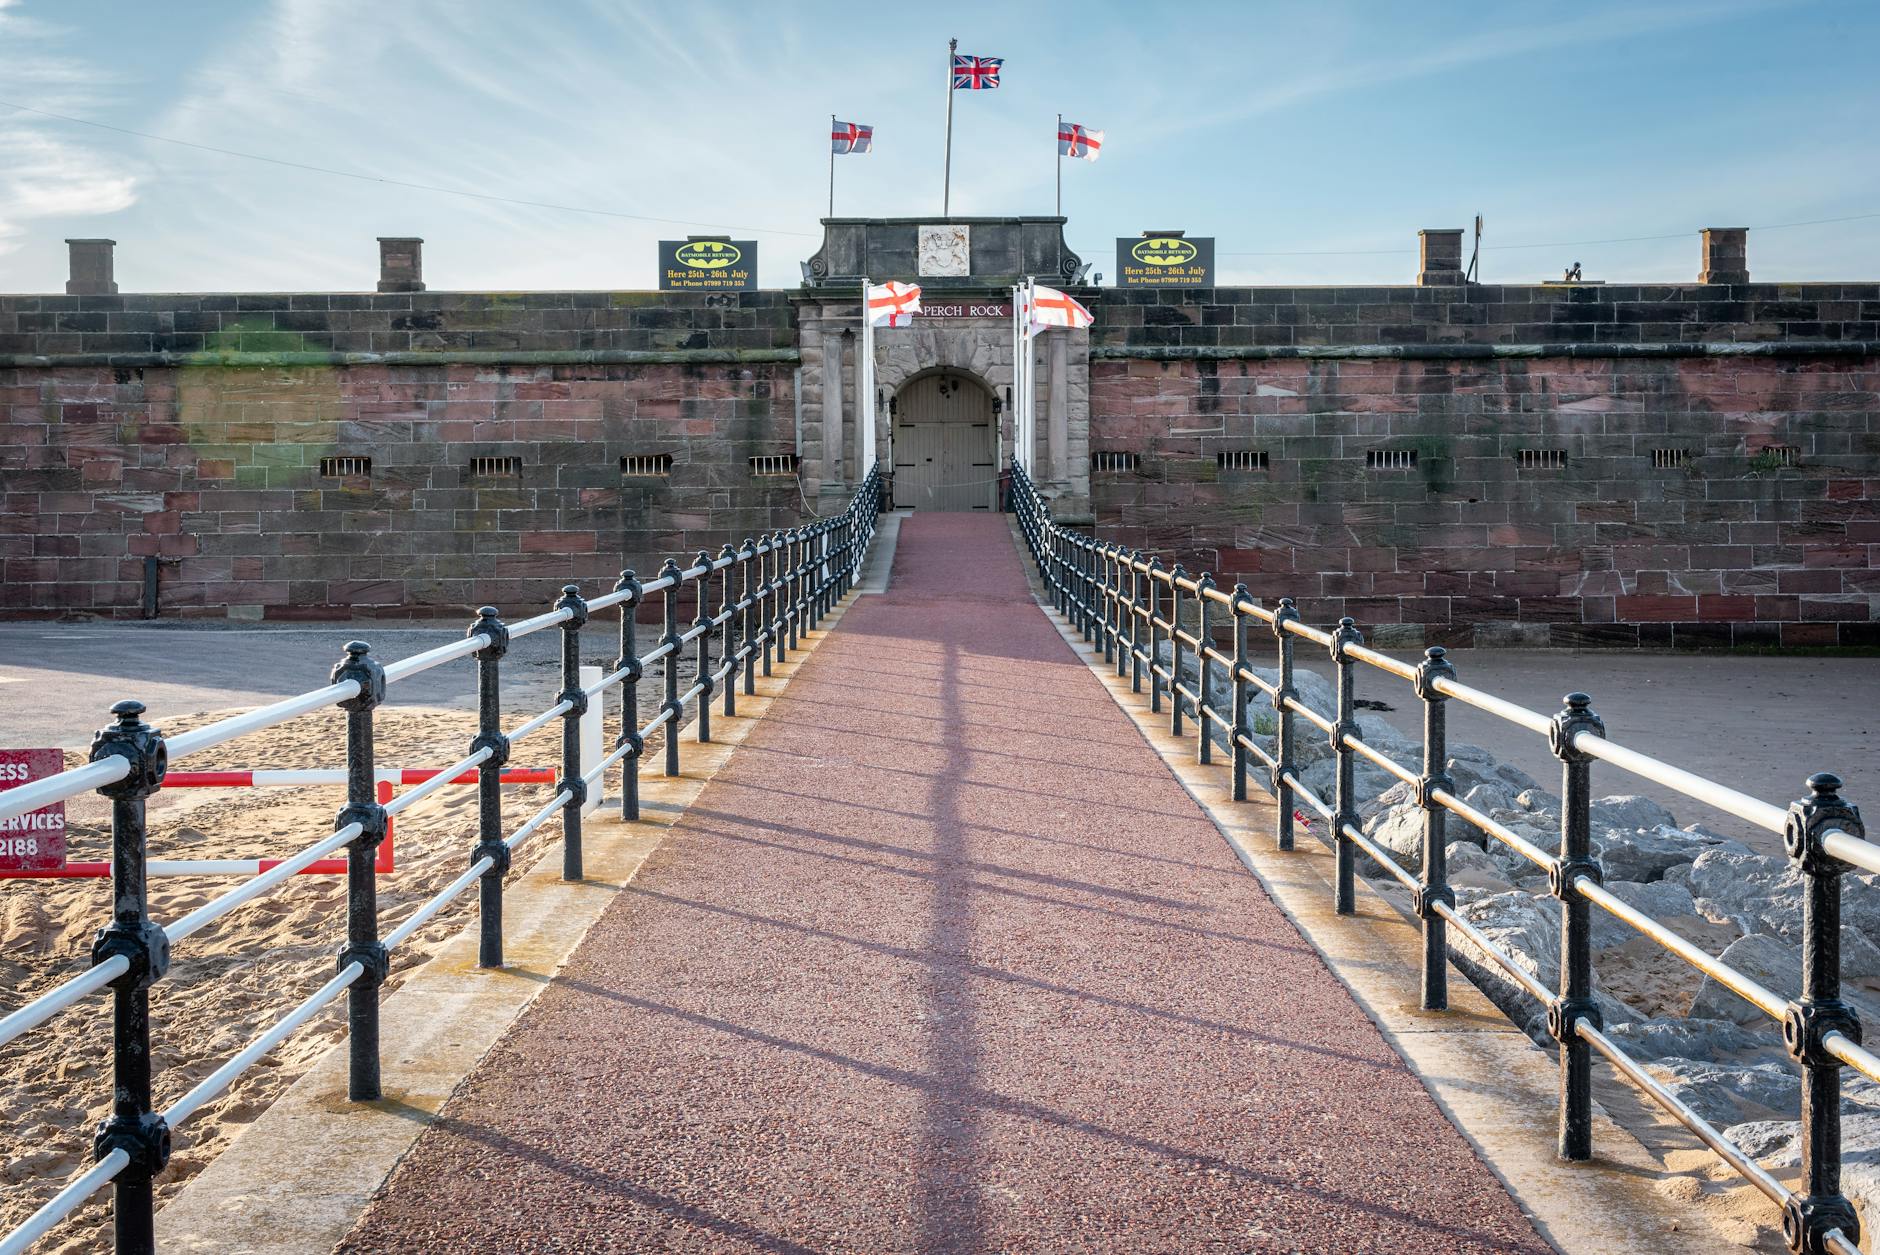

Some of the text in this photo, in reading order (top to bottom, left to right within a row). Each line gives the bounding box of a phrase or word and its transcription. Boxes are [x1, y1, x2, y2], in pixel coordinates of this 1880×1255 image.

[667, 270, 686, 278] Here
[688, 270, 704, 278] 25th
[711, 270, 727, 278] 26th
[731, 270, 749, 280] July
[1124, 267, 1143, 275] Here
[1145, 267, 1162, 275] 25th
[1168, 267, 1184, 275] 26th
[1188, 267, 1206, 277] July
[924, 305, 962, 316] PERCH
[970, 305, 1004, 316] ROCK
